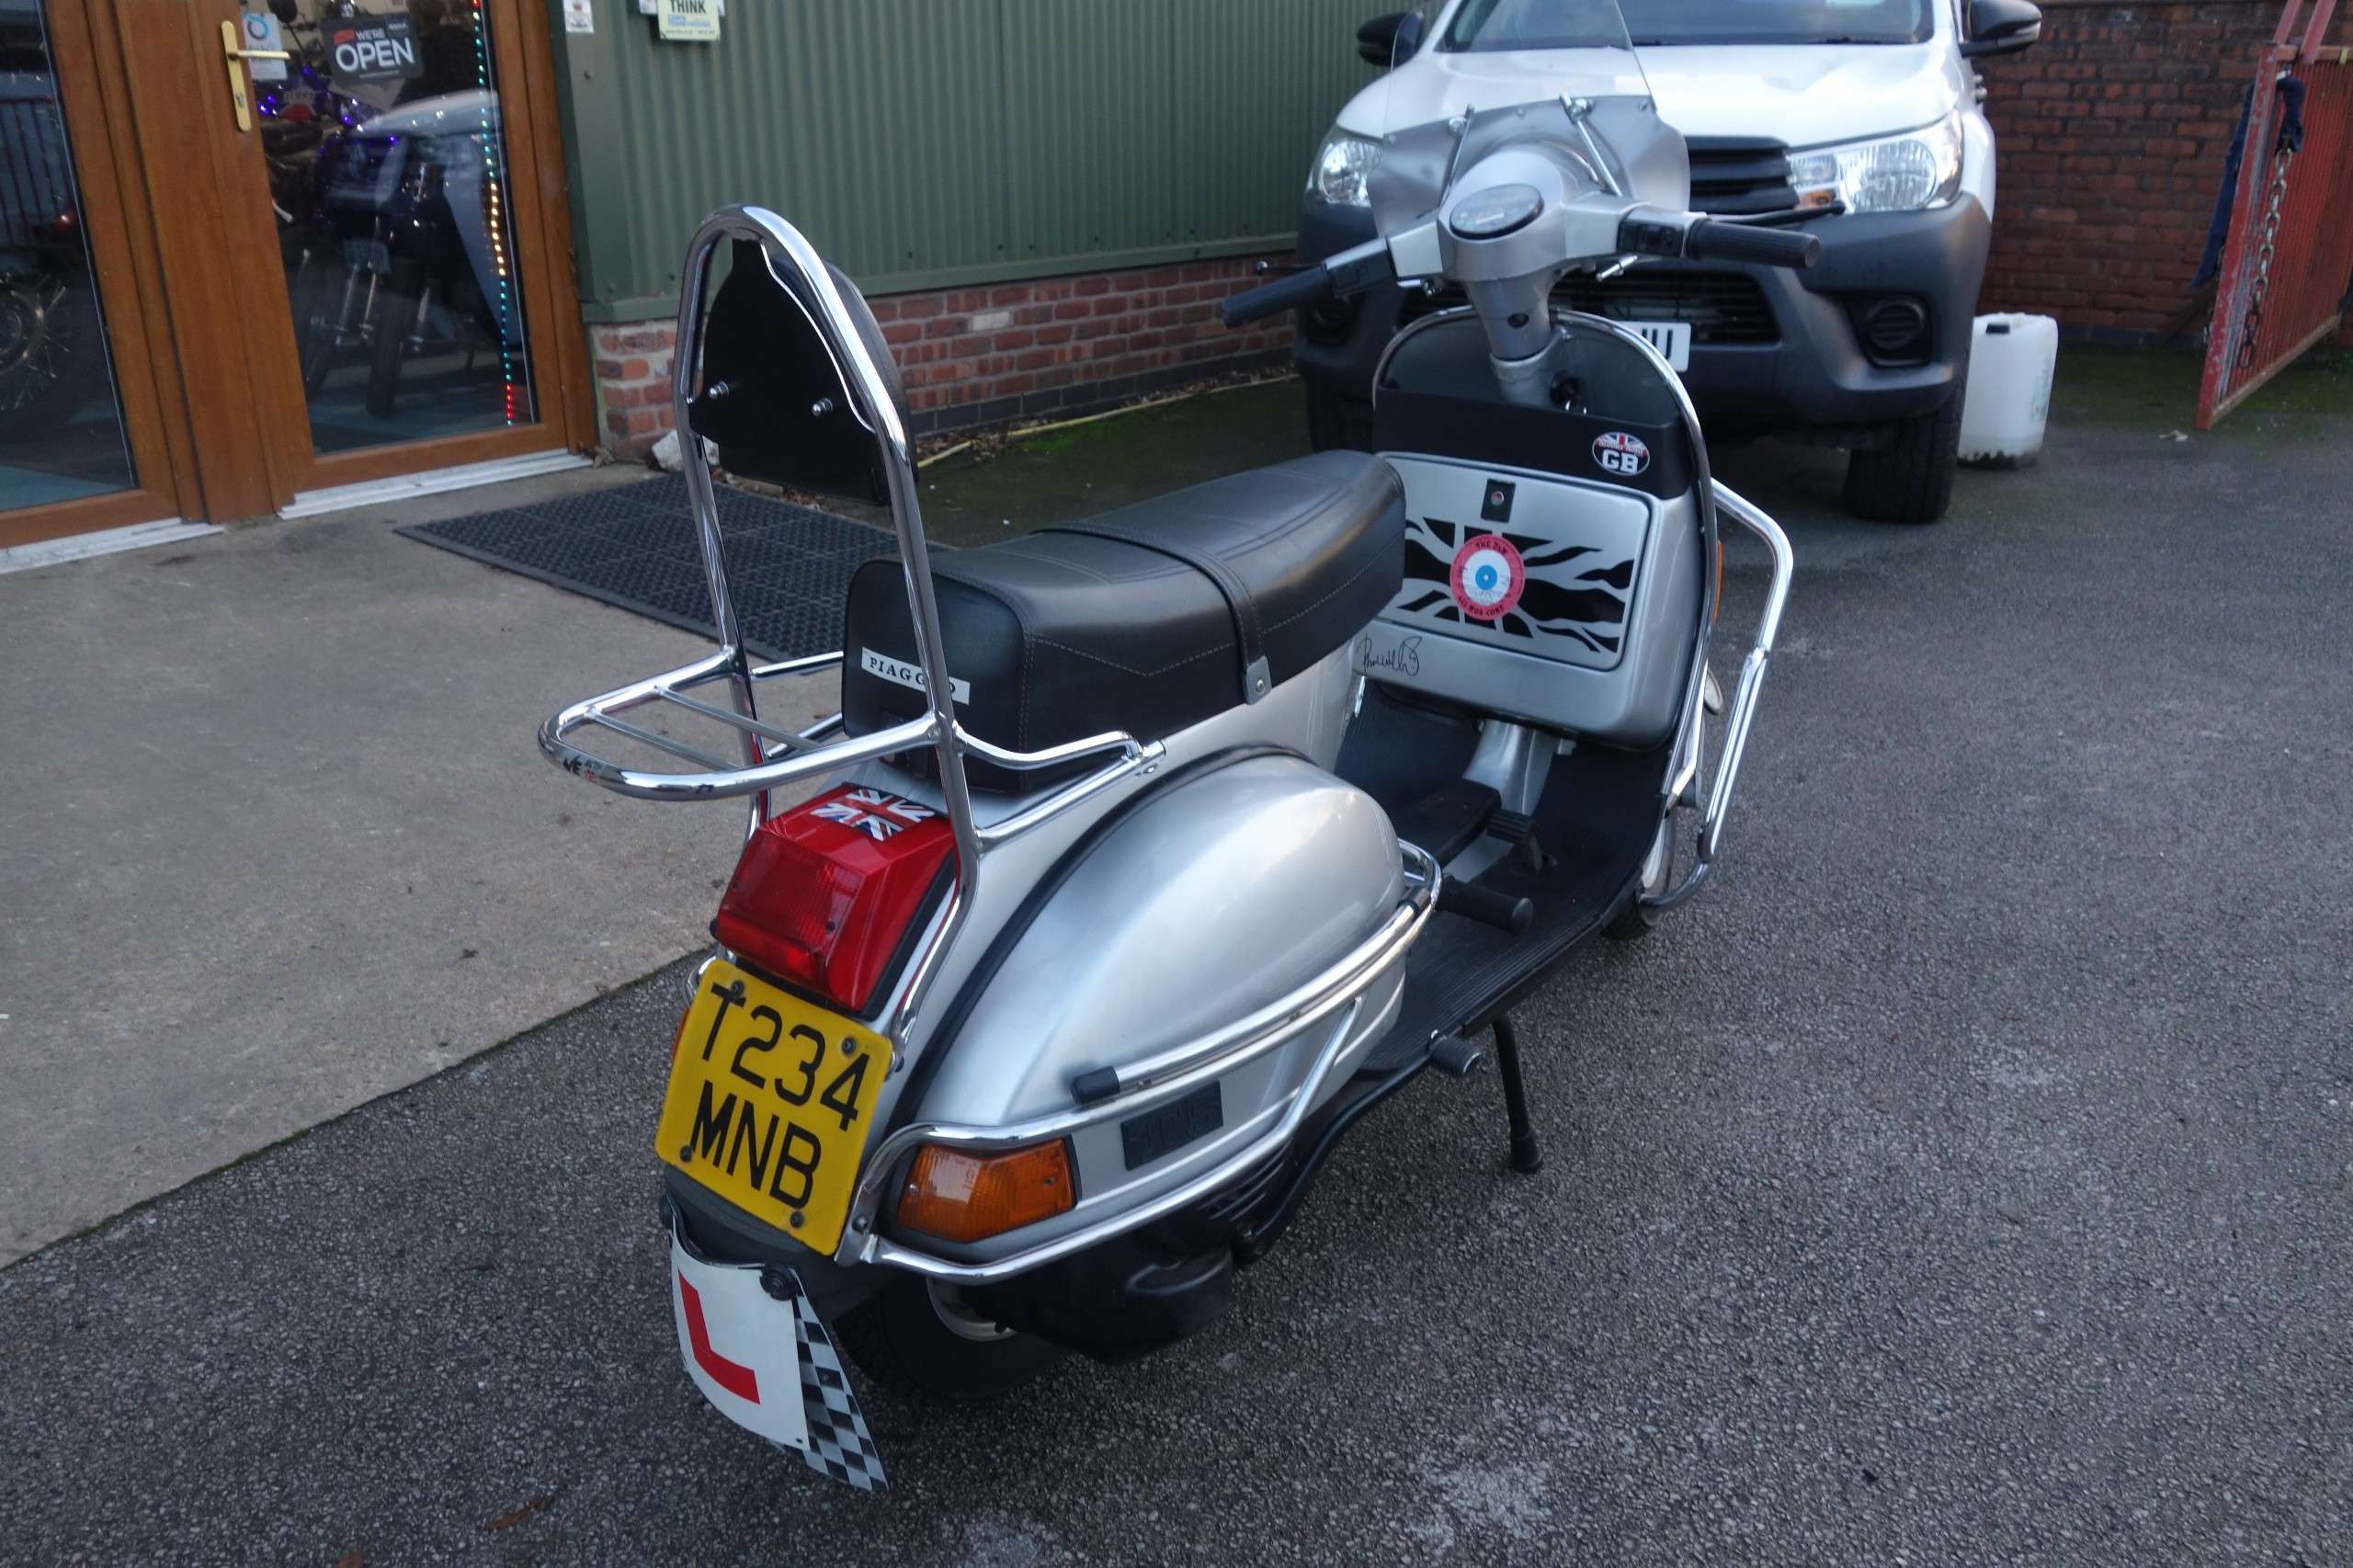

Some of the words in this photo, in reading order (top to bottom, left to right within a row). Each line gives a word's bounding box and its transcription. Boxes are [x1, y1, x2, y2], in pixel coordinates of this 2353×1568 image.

[671, 0, 706, 14] THINK
[335, 37, 414, 73] OPEN
[1602, 449, 1638, 473] GB
[701, 983, 870, 1132] T234
[690, 1079, 822, 1210] MNB
[678, 1268, 761, 1405] L
